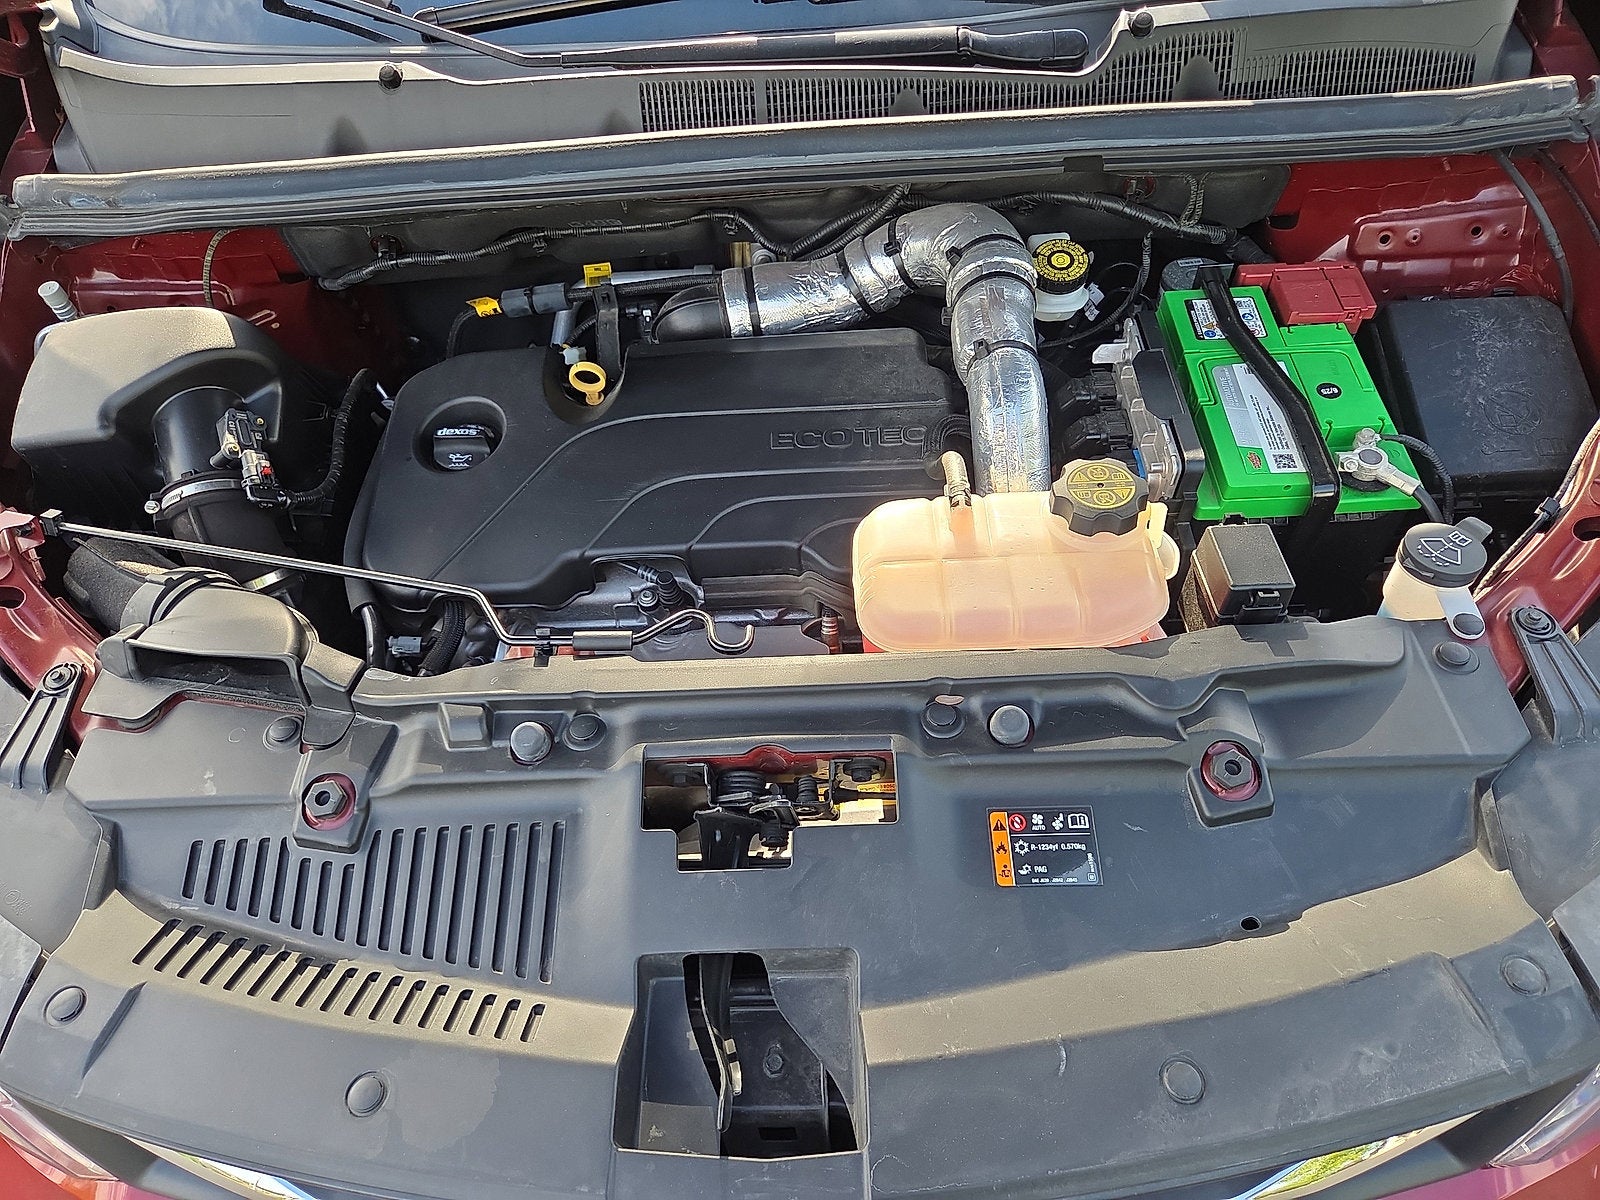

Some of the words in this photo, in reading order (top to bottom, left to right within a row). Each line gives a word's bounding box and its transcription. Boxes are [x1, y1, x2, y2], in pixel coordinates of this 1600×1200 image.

[436, 427, 479, 436] dexos
[770, 424, 928, 450] ECOTEC
[1034, 865, 1048, 873] PAG
